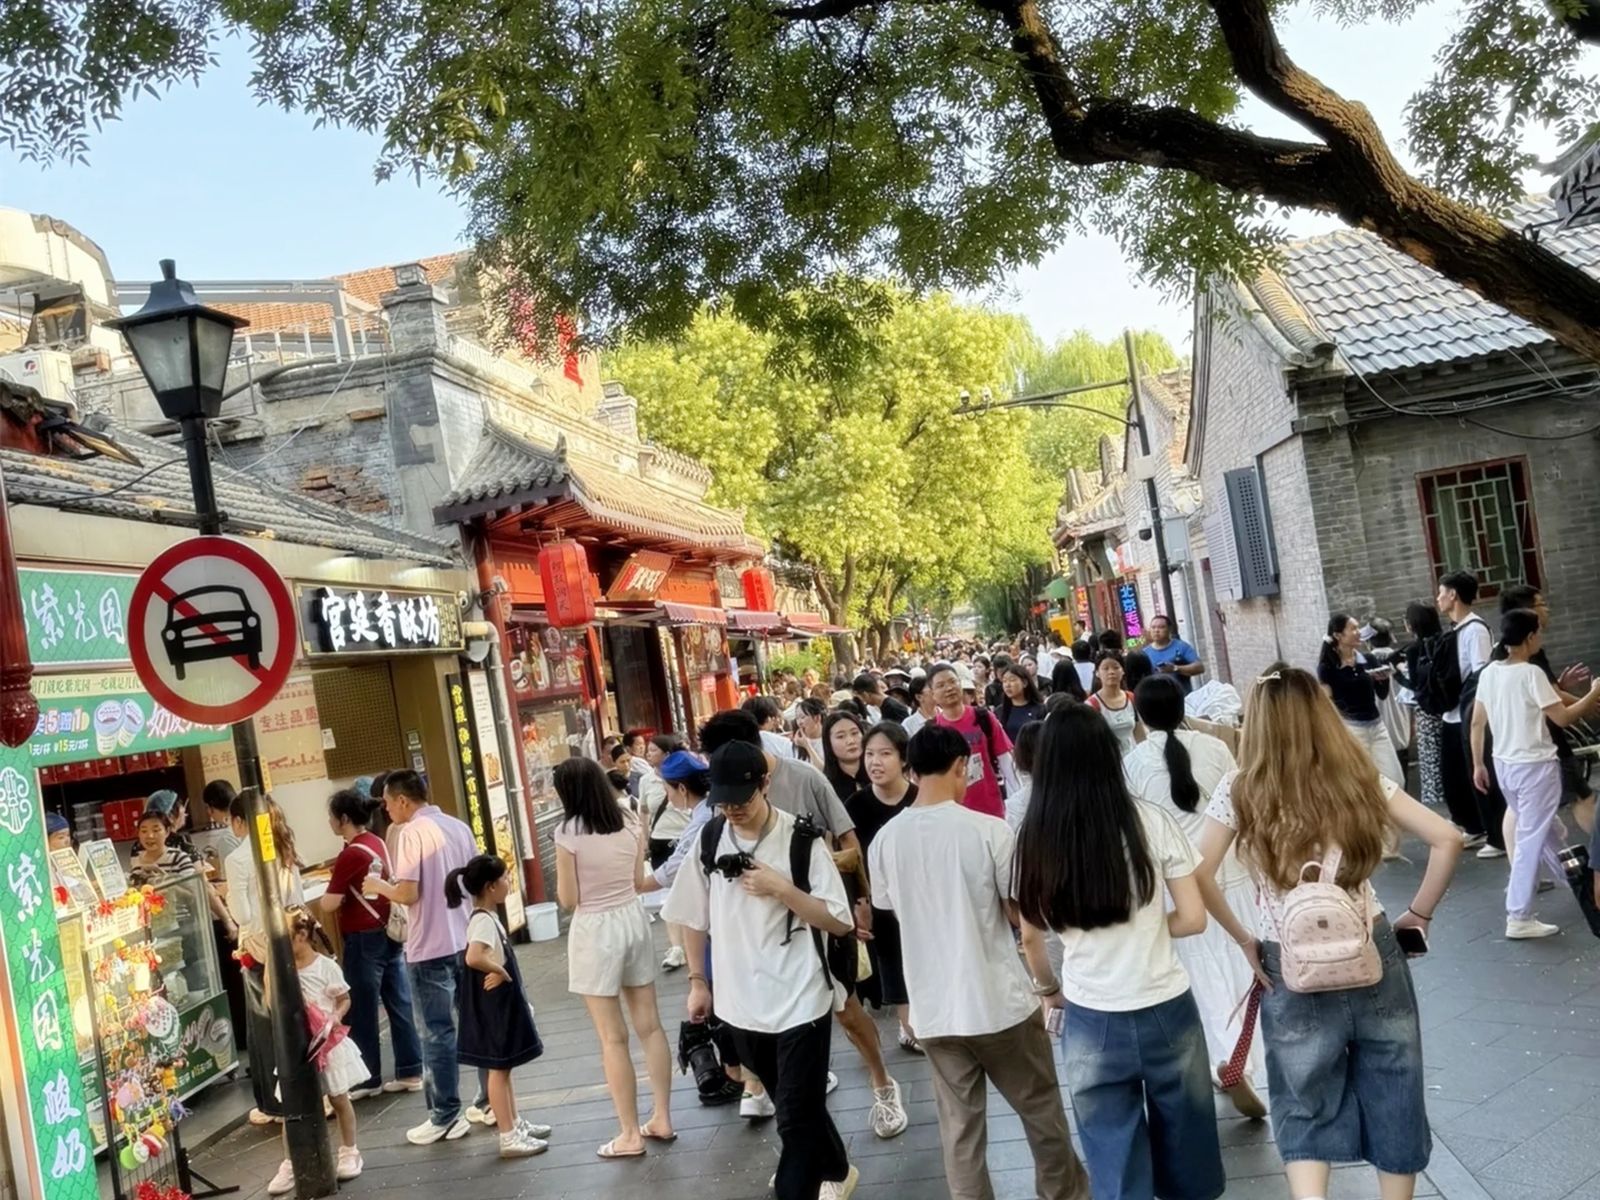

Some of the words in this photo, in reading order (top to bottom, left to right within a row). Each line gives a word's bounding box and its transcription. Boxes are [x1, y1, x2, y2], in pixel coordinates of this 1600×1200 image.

[31, 582, 126, 650] 紫光园
[321, 585, 440, 652] 宫廷香酥坊
